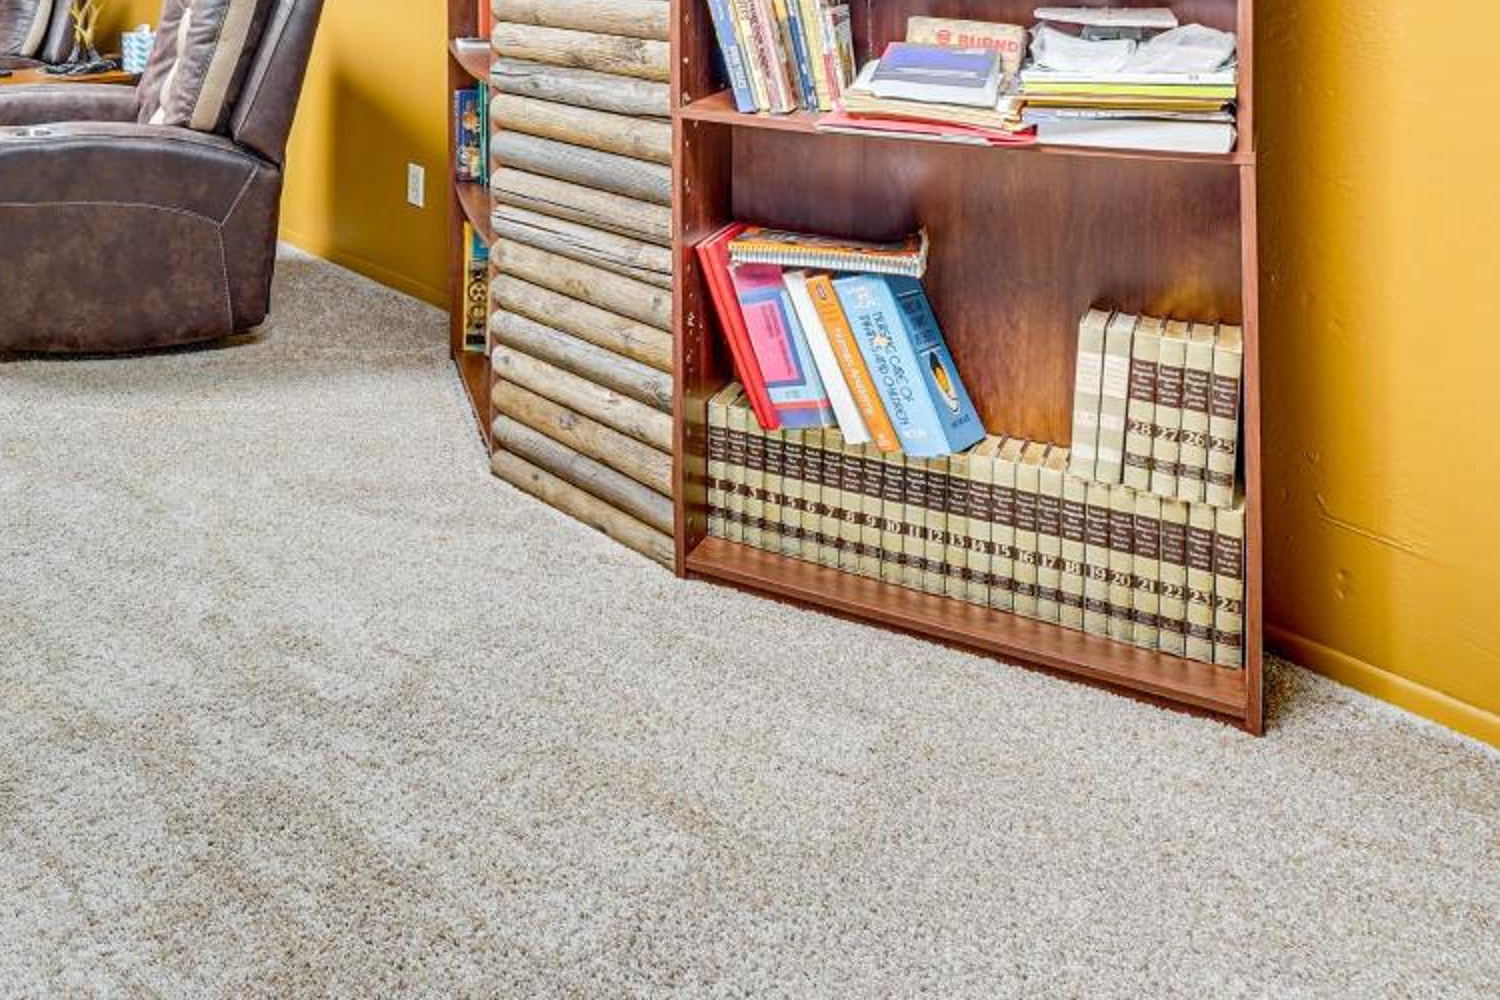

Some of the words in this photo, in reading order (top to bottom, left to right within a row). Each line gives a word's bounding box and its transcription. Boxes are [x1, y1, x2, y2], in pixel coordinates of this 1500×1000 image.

[1130, 422, 1151, 435] 28
[1159, 427, 1178, 442] 27
[1183, 431, 1205, 446] 26
[1211, 438, 1234, 454] 25
[886, 521, 900, 534] 10
[909, 525, 920, 537] 11
[929, 529, 943, 544] 12
[950, 534, 964, 547] 13
[995, 544, 1011, 558] 15
[1019, 550, 1034, 564] 16
[1042, 555, 1055, 568] 17
[1066, 561, 1080, 575] 18
[1090, 567, 1106, 581] 19
[1113, 572, 1131, 587] 20
[1140, 578, 1155, 593] 21
[1164, 584, 1183, 599] 22
[1189, 588, 1210, 607] 23
[1217, 597, 1239, 613] 24
